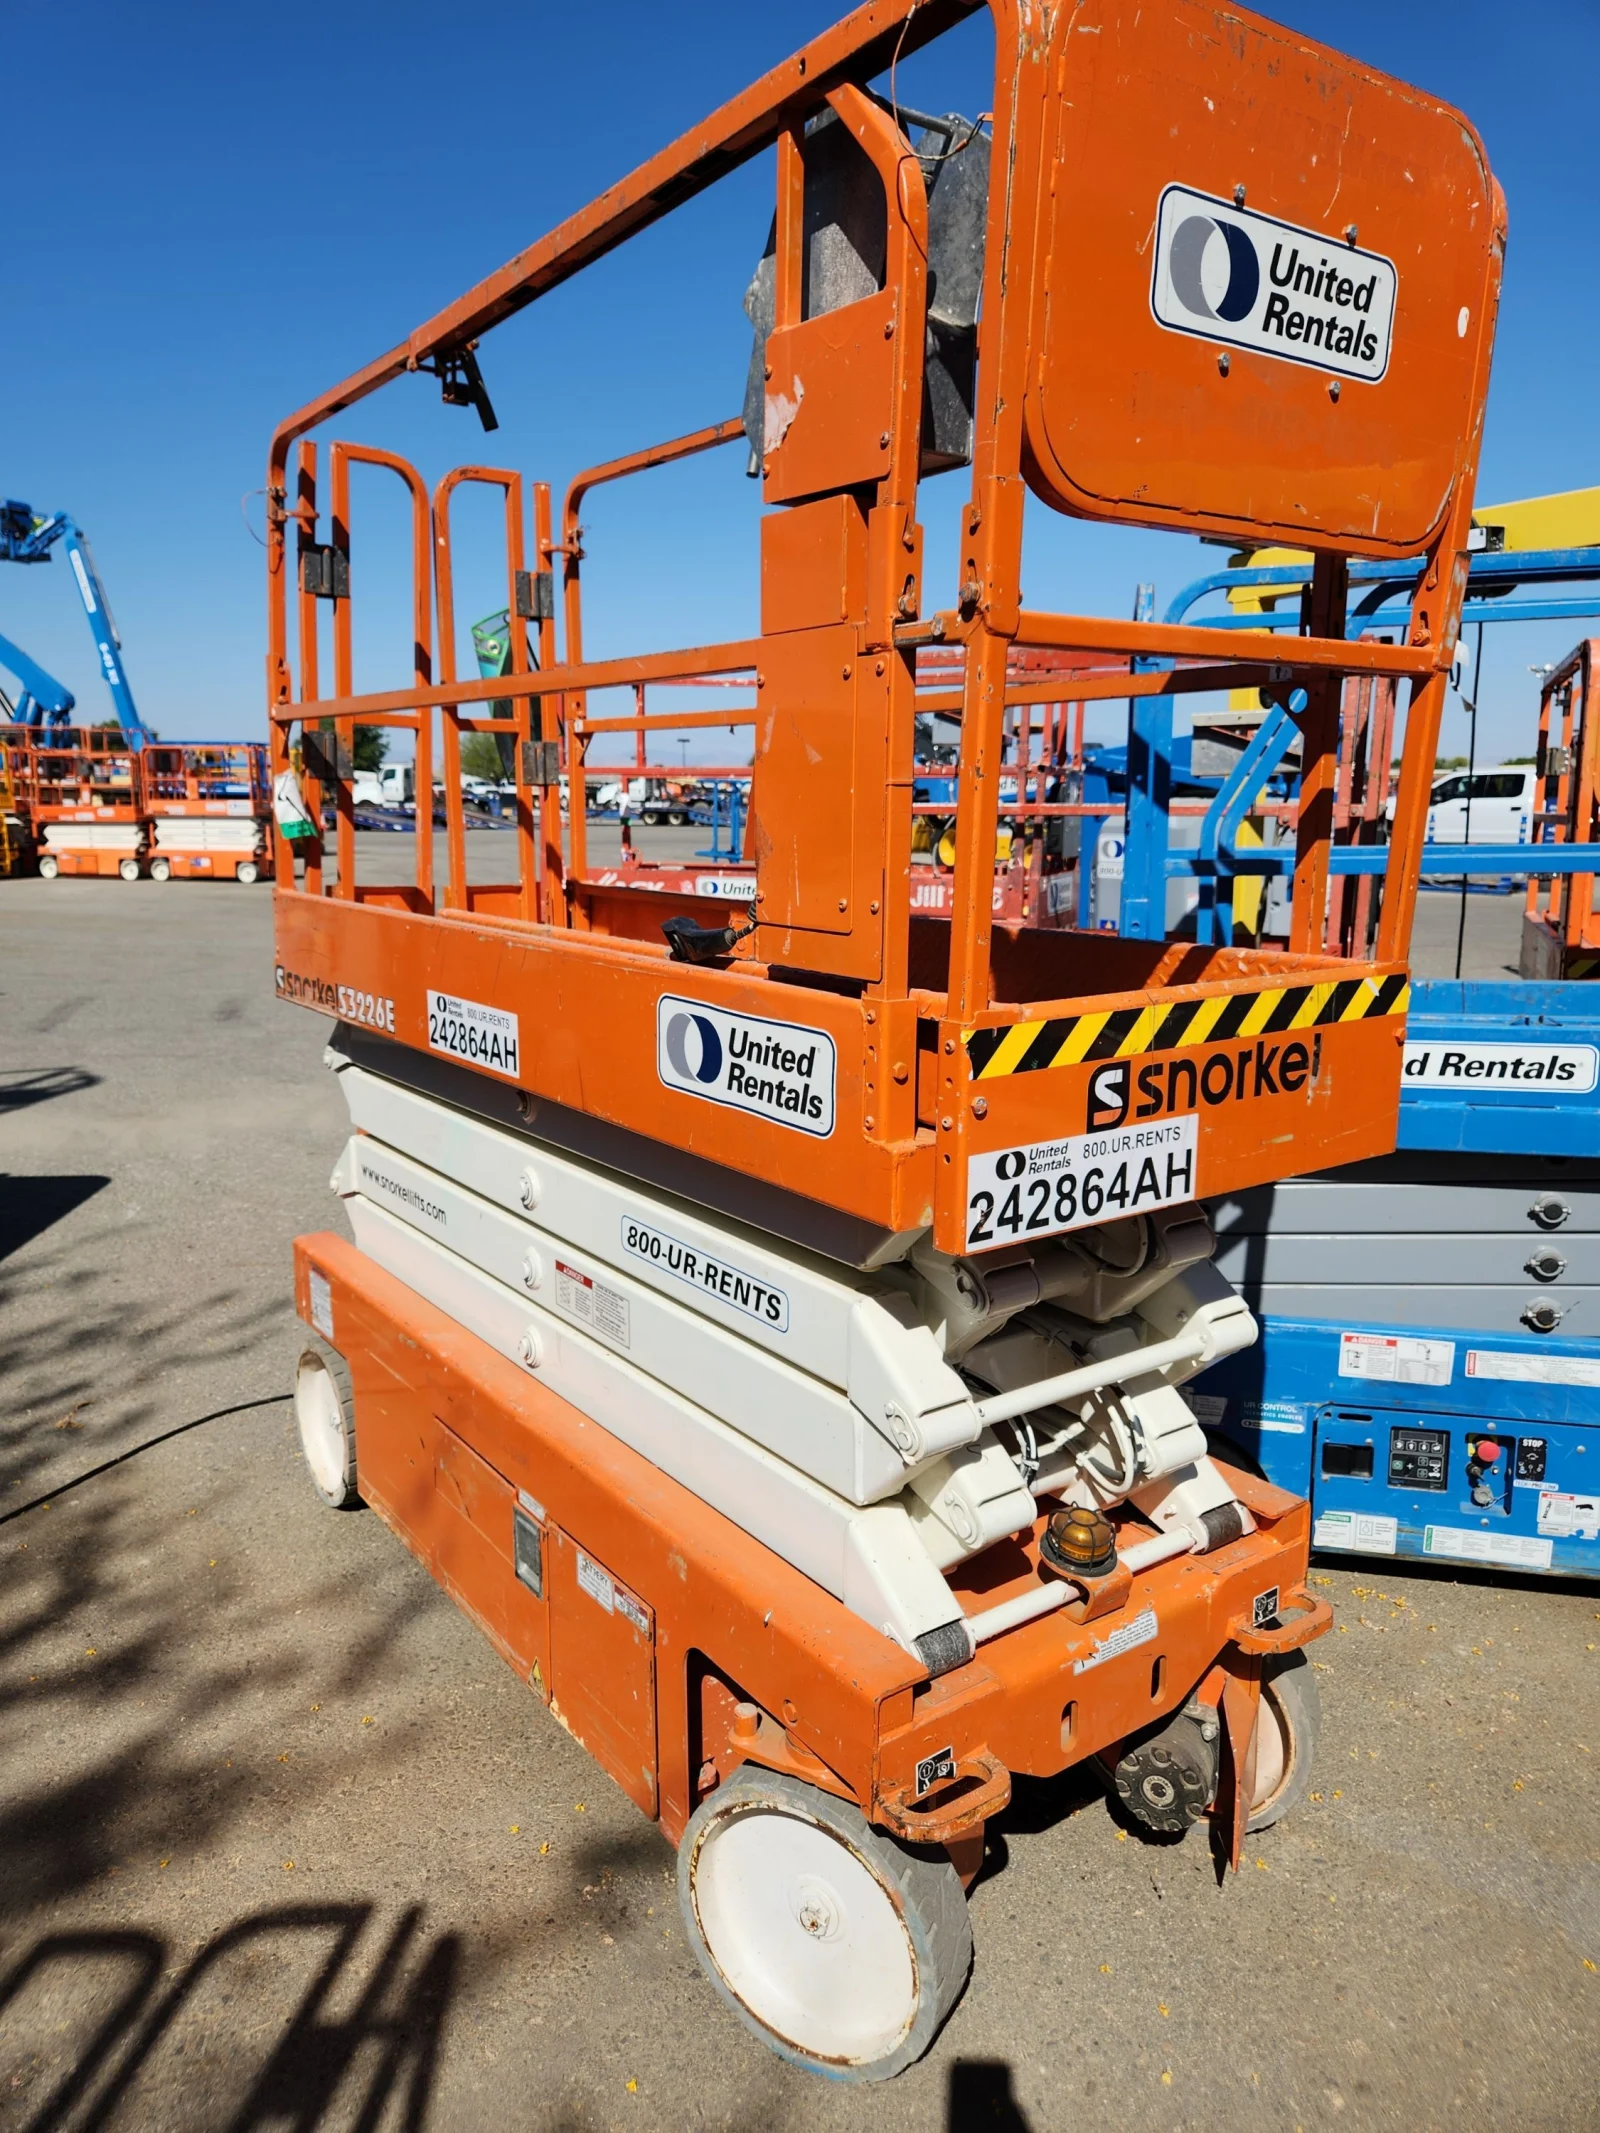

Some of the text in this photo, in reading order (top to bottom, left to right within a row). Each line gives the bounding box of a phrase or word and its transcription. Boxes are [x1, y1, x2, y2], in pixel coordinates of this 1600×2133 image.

[1269, 243, 1377, 313] United
[1262, 292, 1379, 361] Rentals
[723, 883, 757, 895] Unite
[338, 984, 396, 1034] S3226E
[467, 1008, 510, 1029] 800.UR.RENTS
[430, 1013, 517, 1072] 242864AH
[728, 1027, 816, 1078] United
[1438, 1052, 1577, 1080] Rentals
[726, 1062, 823, 1119] Rentals
[1136, 1033, 1322, 1117] snorkel
[1028, 1142, 1068, 1161] United
[1028, 1155, 1071, 1175] Rentals
[1083, 1126, 1181, 1159] 800.UR.RENTS
[361, 1165, 447, 1225] www.snorkellifts.com
[968, 1148, 1193, 1244] 242864AH
[627, 1226, 782, 1321] 800-UR-RENTS
[1259, 1402, 1299, 1413] CONTROL
[1522, 1439, 1543, 1448] STOP
